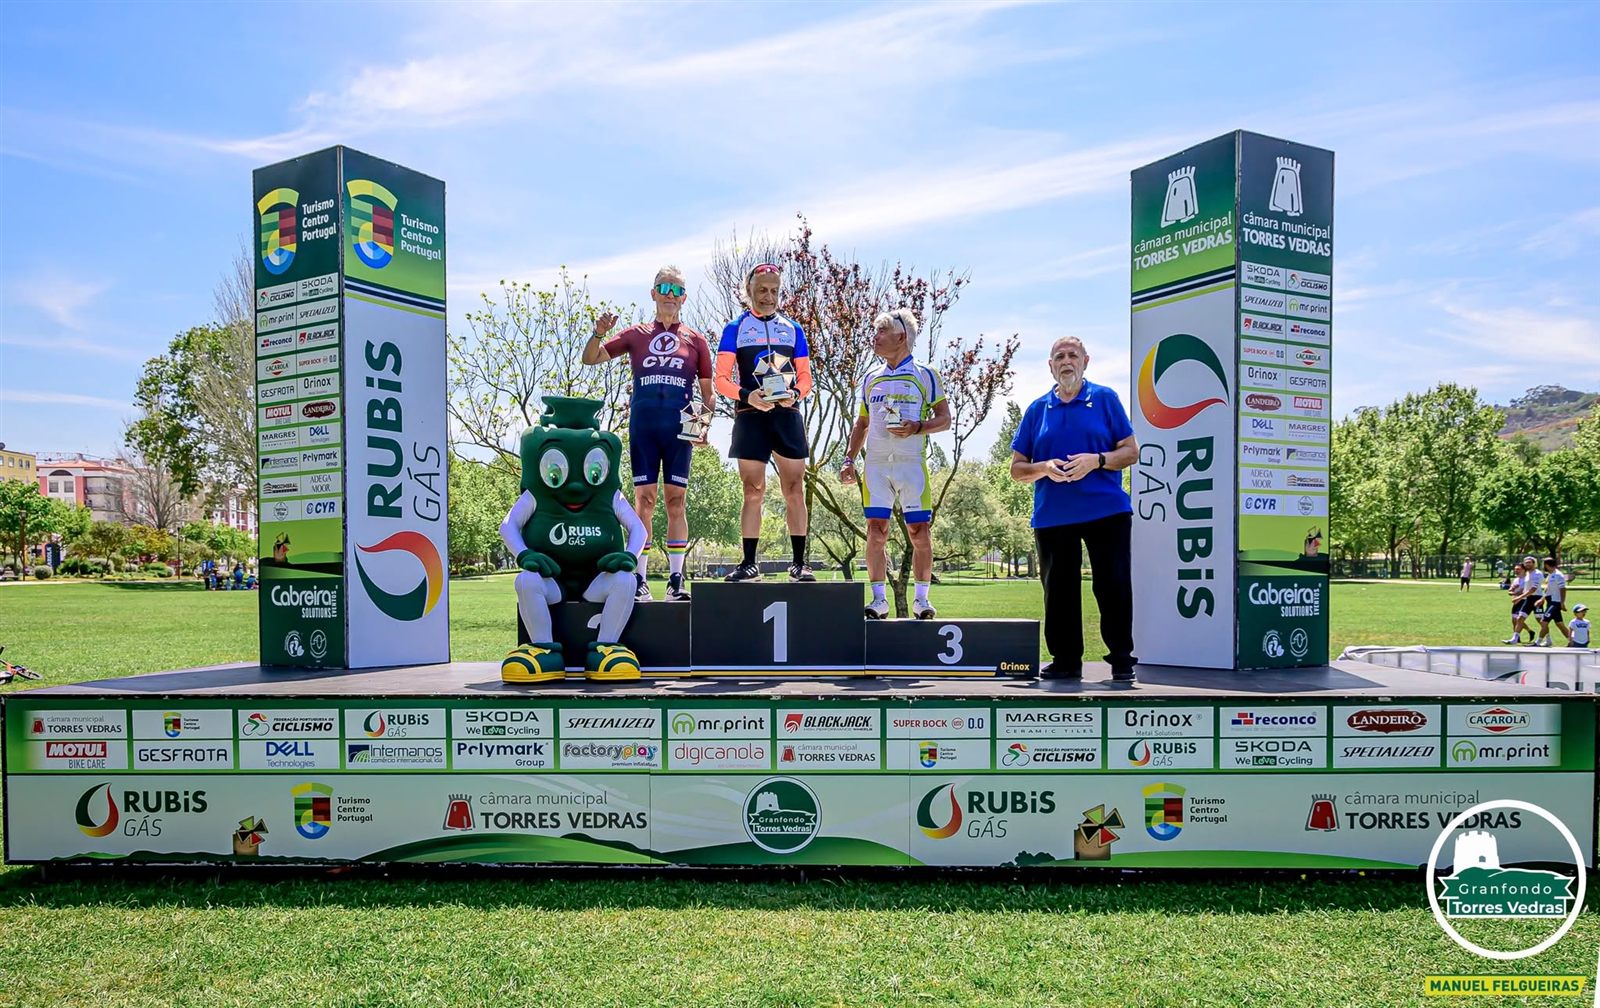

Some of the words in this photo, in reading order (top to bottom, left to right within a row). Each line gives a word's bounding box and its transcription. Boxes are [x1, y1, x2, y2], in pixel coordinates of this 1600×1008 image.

[302, 199, 334, 215] Turismo
[302, 214, 329, 228] Centro
[401, 214, 439, 234] Turismo
[1243, 212, 1279, 230] câmara
[1282, 220, 1330, 240] municipal
[302, 224, 337, 242] Portugal
[401, 228, 432, 246] Centro
[1134, 233, 1171, 254] câmara
[1174, 211, 1232, 240] municipal
[1243, 228, 1286, 250] TORRES
[1288, 234, 1330, 257] VEDRAS
[401, 240, 442, 260] Portugal
[1134, 245, 1180, 271] TORRES
[1183, 230, 1232, 256] VEDRAS
[1300, 281, 1328, 291] CICLISMO
[270, 291, 294, 302] CICLISMO
[1244, 296, 1283, 308] SPECIALIZED
[298, 305, 336, 319] SPECIALIZED
[1300, 328, 1326, 336] reconco
[270, 337, 292, 347] reconco
[642, 356, 685, 370] CYR
[1248, 366, 1278, 380] Brinox
[304, 377, 332, 389] Brinox
[640, 375, 687, 388] TORREENSE
[1290, 376, 1326, 388] GESFROTA
[260, 386, 294, 398] GESFROTA
[1296, 398, 1322, 408] MOTUL
[266, 406, 291, 418] MOTUL
[1252, 418, 1274, 430] DELL
[1288, 424, 1326, 432] MARGRES
[262, 430, 296, 441] MARGRES
[310, 426, 329, 436] DELL
[302, 451, 338, 462] Polymark
[1244, 446, 1281, 456] Polymark
[310, 474, 332, 483] ADEGA
[1250, 469, 1273, 478] ADEGA
[407, 442, 441, 522] GÁS
[1139, 443, 1172, 522] GÁS
[315, 502, 335, 514] CYR
[1254, 498, 1276, 510] CYR
[568, 534, 586, 546] GÁS
[272, 585, 331, 606] Cabreira
[1248, 582, 1313, 604] Cabreira
[302, 607, 332, 619] SOLUTIONS
[1280, 605, 1314, 617] SOLUTIONS
[763, 601, 788, 662] 1
[937, 624, 964, 664] 3
[1000, 662, 1030, 671] Brinox
[72, 715, 104, 724] municipal
[466, 712, 540, 722] SKODA
[565, 718, 656, 728] SPECIALIZED
[804, 715, 872, 728] BLACKJACK
[1006, 713, 1094, 722] MARGRES
[1125, 710, 1192, 727] Brinox
[1255, 714, 1316, 725] reconco
[1352, 714, 1421, 726] LANDEIRO
[1469, 715, 1526, 726] CAÇAROLA
[48, 725, 83, 733] TORRES
[86, 725, 122, 733] VEDRAS
[272, 722, 333, 732] CICLISMO
[698, 716, 764, 733] mr.print
[893, 720, 920, 728] SUPER
[922, 720, 948, 728] BOCK
[968, 718, 984, 730] 0.0
[387, 726, 407, 737] GÁS
[466, 726, 481, 734] We
[508, 726, 540, 736] Cycling
[48, 744, 104, 756] MOTUL
[266, 742, 314, 756] DELL
[370, 744, 442, 757] Intermanos
[457, 742, 544, 758] Polymark
[824, 744, 858, 753] municipal
[1235, 740, 1312, 752] SKODA
[1340, 746, 1435, 758] SPECIALIZED
[1479, 742, 1549, 761] mr.print
[138, 748, 228, 762] GESFROTA
[674, 743, 764, 764] digicanola
[799, 753, 836, 762] TORRES
[838, 753, 876, 762] VEDRAS
[1033, 752, 1095, 762] CICLISMO
[68, 760, 84, 768] BIKE
[86, 759, 106, 768] CARE
[266, 759, 315, 768] Technologies
[516, 758, 545, 768] Group
[1152, 756, 1173, 766] GÁS
[1235, 756, 1250, 765] We
[1278, 756, 1313, 766] Cycling
[337, 796, 370, 804] Turismo
[480, 791, 532, 805] câmara
[537, 790, 608, 808] municipal
[1190, 797, 1226, 805] Turismo
[1344, 791, 1399, 805] câmara
[1404, 790, 1480, 808] municipal
[1190, 806, 1220, 814] Centro
[337, 814, 373, 824] Portugal
[480, 812, 560, 829] TORRES
[568, 812, 648, 829] VEDRAS
[758, 816, 806, 824] Granfondo
[1190, 815, 1228, 824] Portugal
[1344, 812, 1430, 829] TORRES
[124, 815, 162, 836] GÁS
[968, 816, 1008, 838] GÁS
